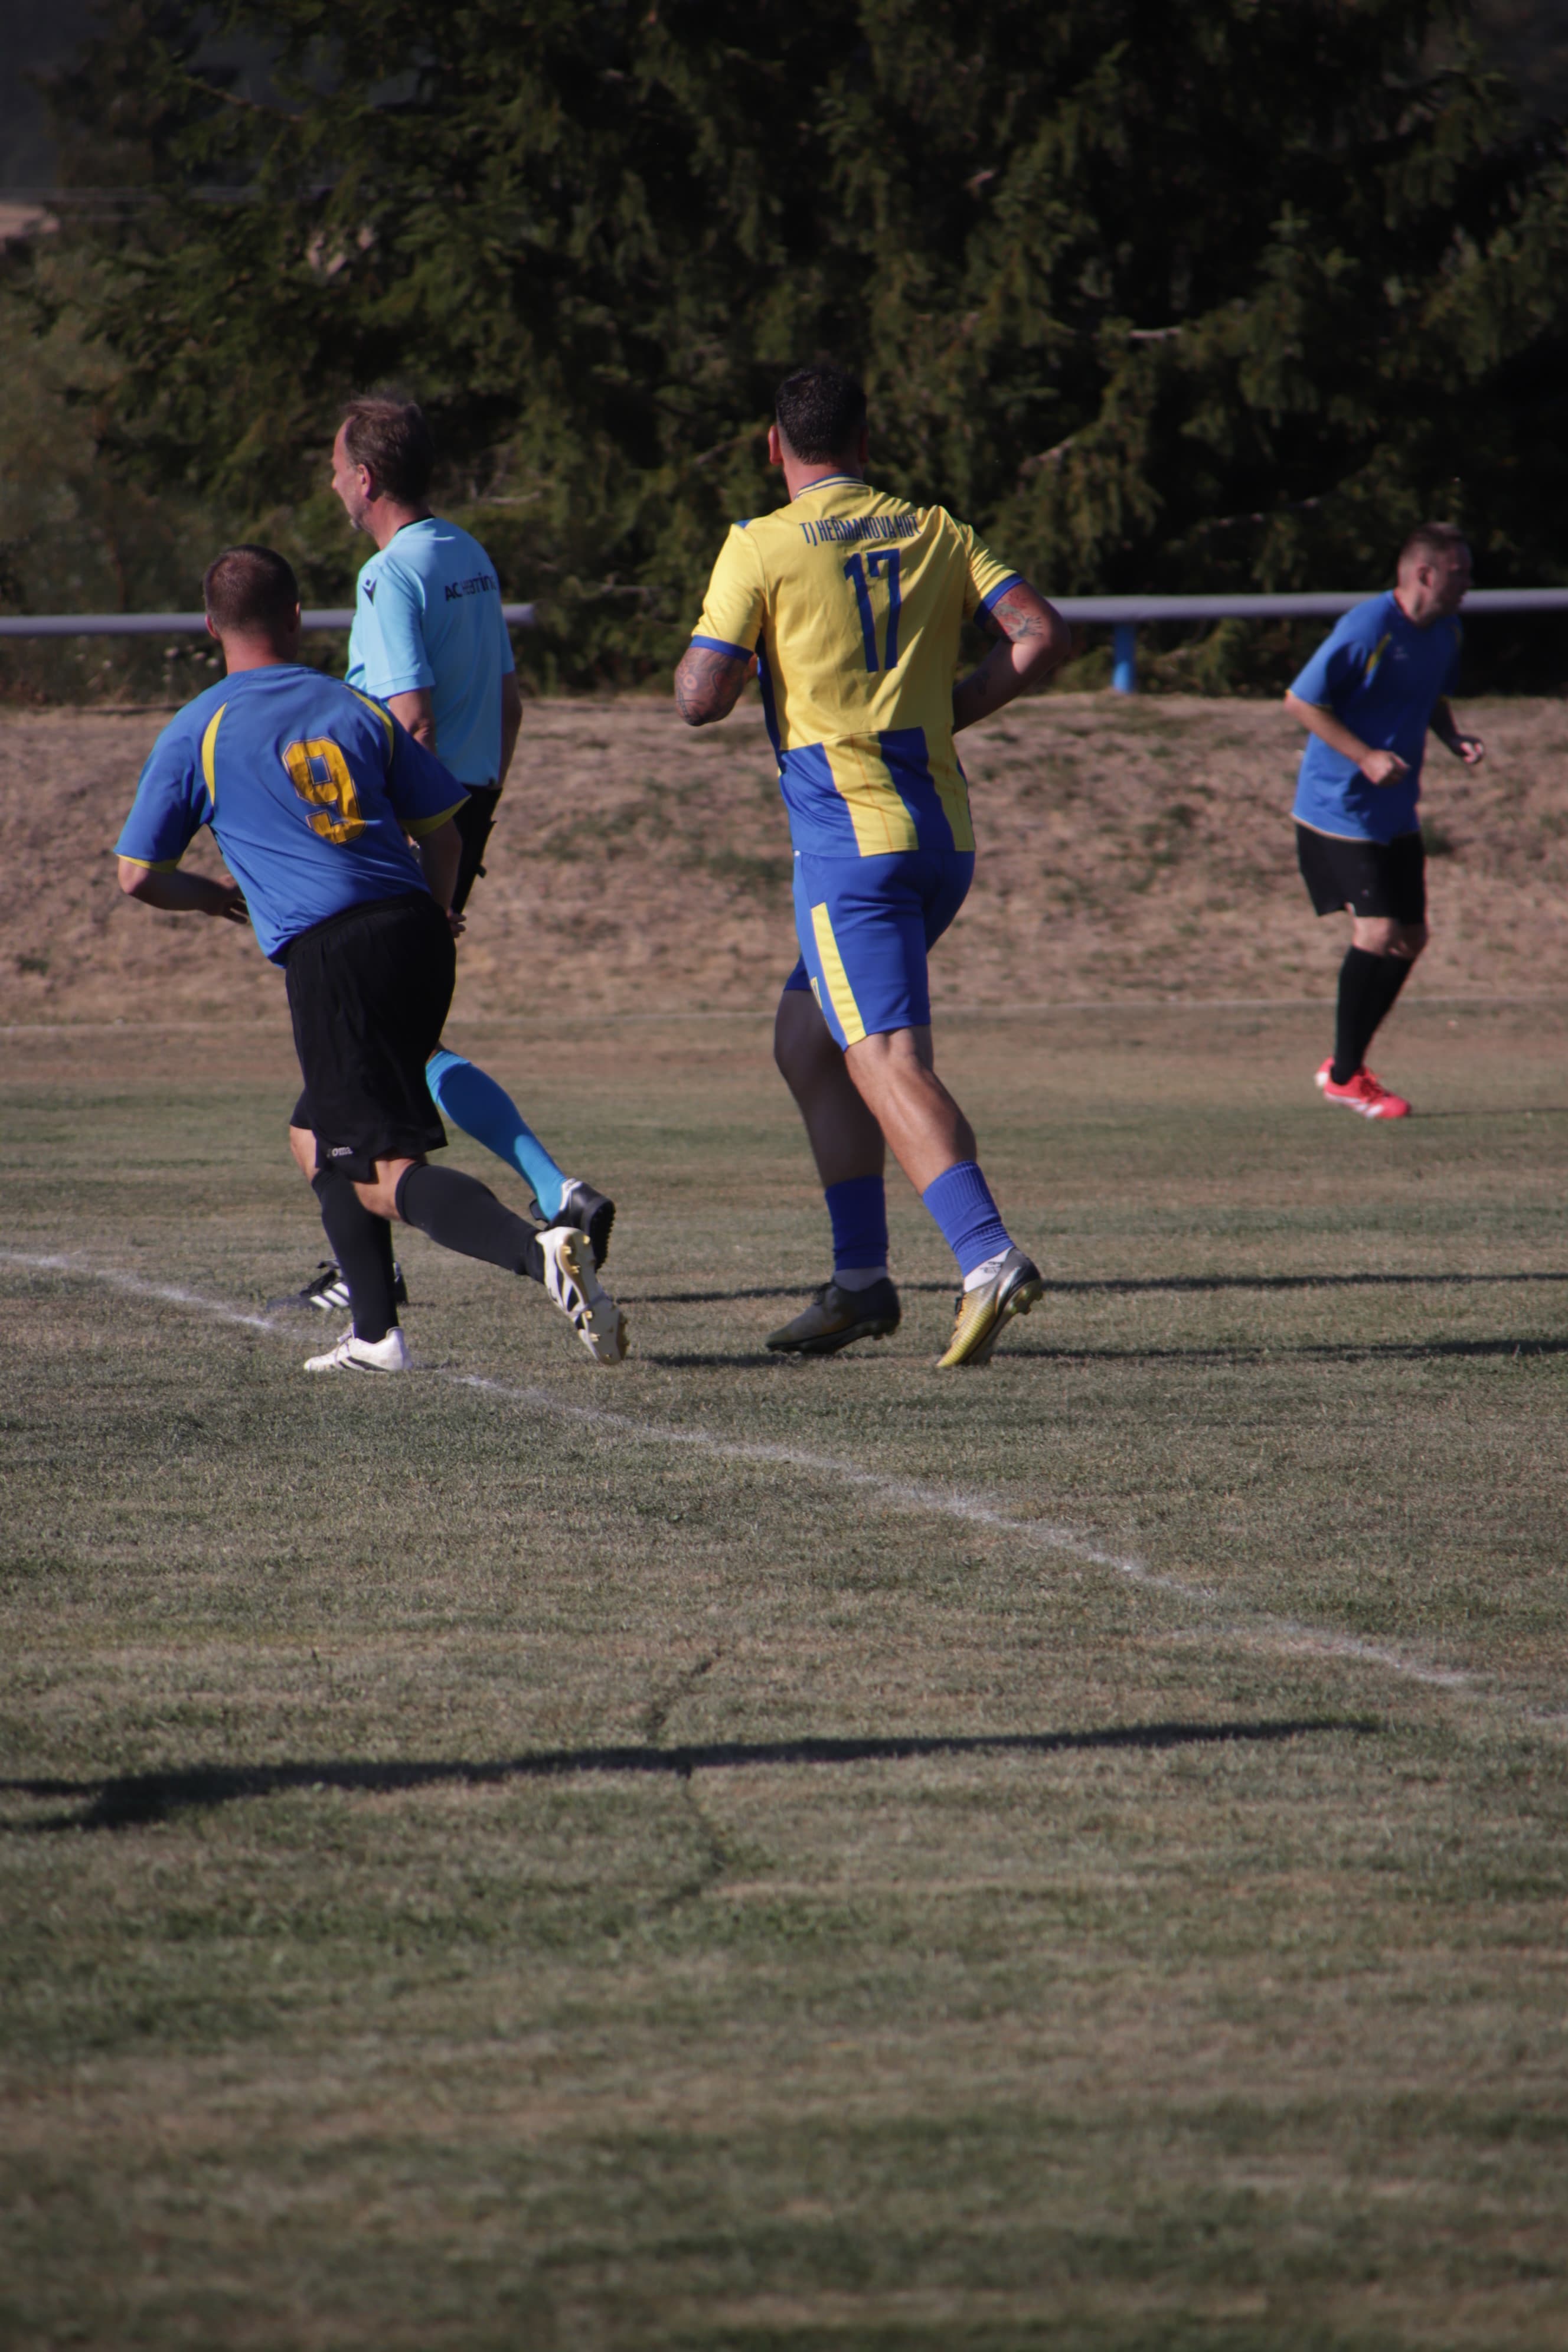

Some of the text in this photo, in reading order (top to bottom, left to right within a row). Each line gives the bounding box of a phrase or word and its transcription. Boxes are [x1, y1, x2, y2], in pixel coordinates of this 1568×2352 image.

[799, 521, 818, 546] TJ
[445, 582, 463, 601] AC
[844, 548, 902, 673] 17
[282, 736, 367, 845] 9
